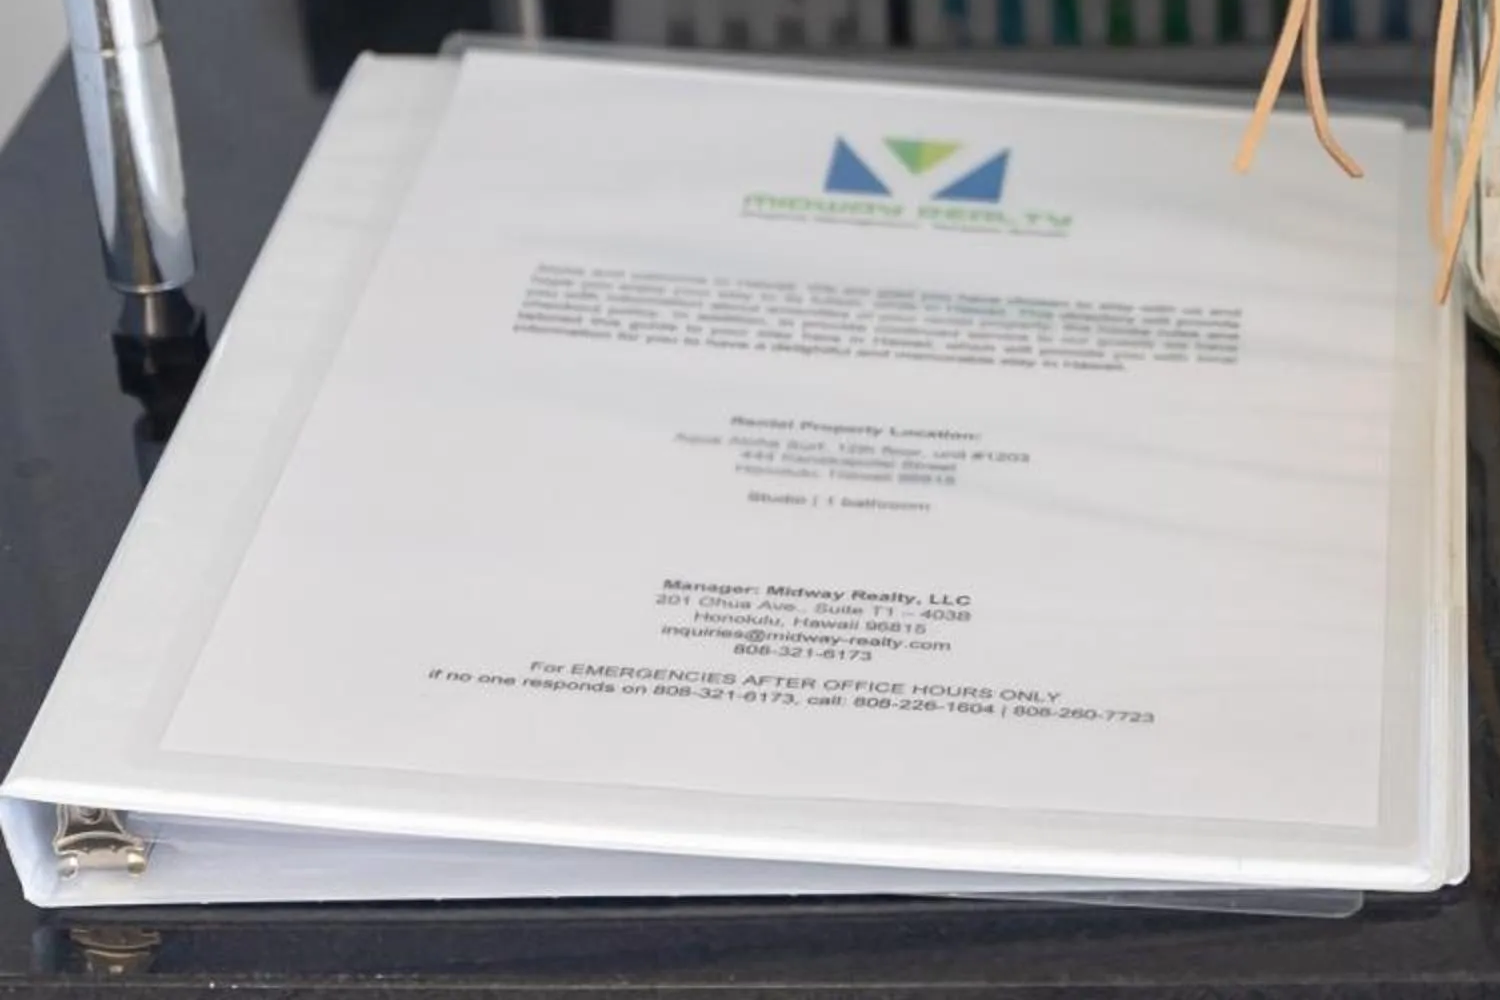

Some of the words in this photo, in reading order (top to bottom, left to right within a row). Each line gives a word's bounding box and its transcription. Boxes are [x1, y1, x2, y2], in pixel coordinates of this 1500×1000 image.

[663, 578, 760, 597] Manager:
[766, 584, 845, 603] Midway
[851, 589, 922, 607] Realty,
[929, 593, 972, 607] LLC
[656, 593, 691, 606] 201
[814, 602, 864, 616] Suite
[873, 605, 894, 617] T1
[921, 608, 972, 622] 4038
[661, 624, 952, 652] inquiries@midway-realty.com
[793, 617, 860, 631] Hawaii
[866, 621, 928, 634] 96815
[733, 643, 873, 661] 808-321-6173
[530, 660, 565, 674] For
[570, 663, 737, 685] EMERGENCIES
[742, 674, 817, 690] AFTER
[823, 678, 905, 695] OFFICE
[912, 684, 994, 699] HOURS
[1000, 688, 1062, 703] ONLY
[446, 671, 472, 682] no
[478, 675, 516, 687] one
[522, 677, 616, 694] responds
[622, 684, 648, 695] on
[854, 696, 996, 715] 808-226-1604
[1013, 705, 1156, 724] 808-260-7723
